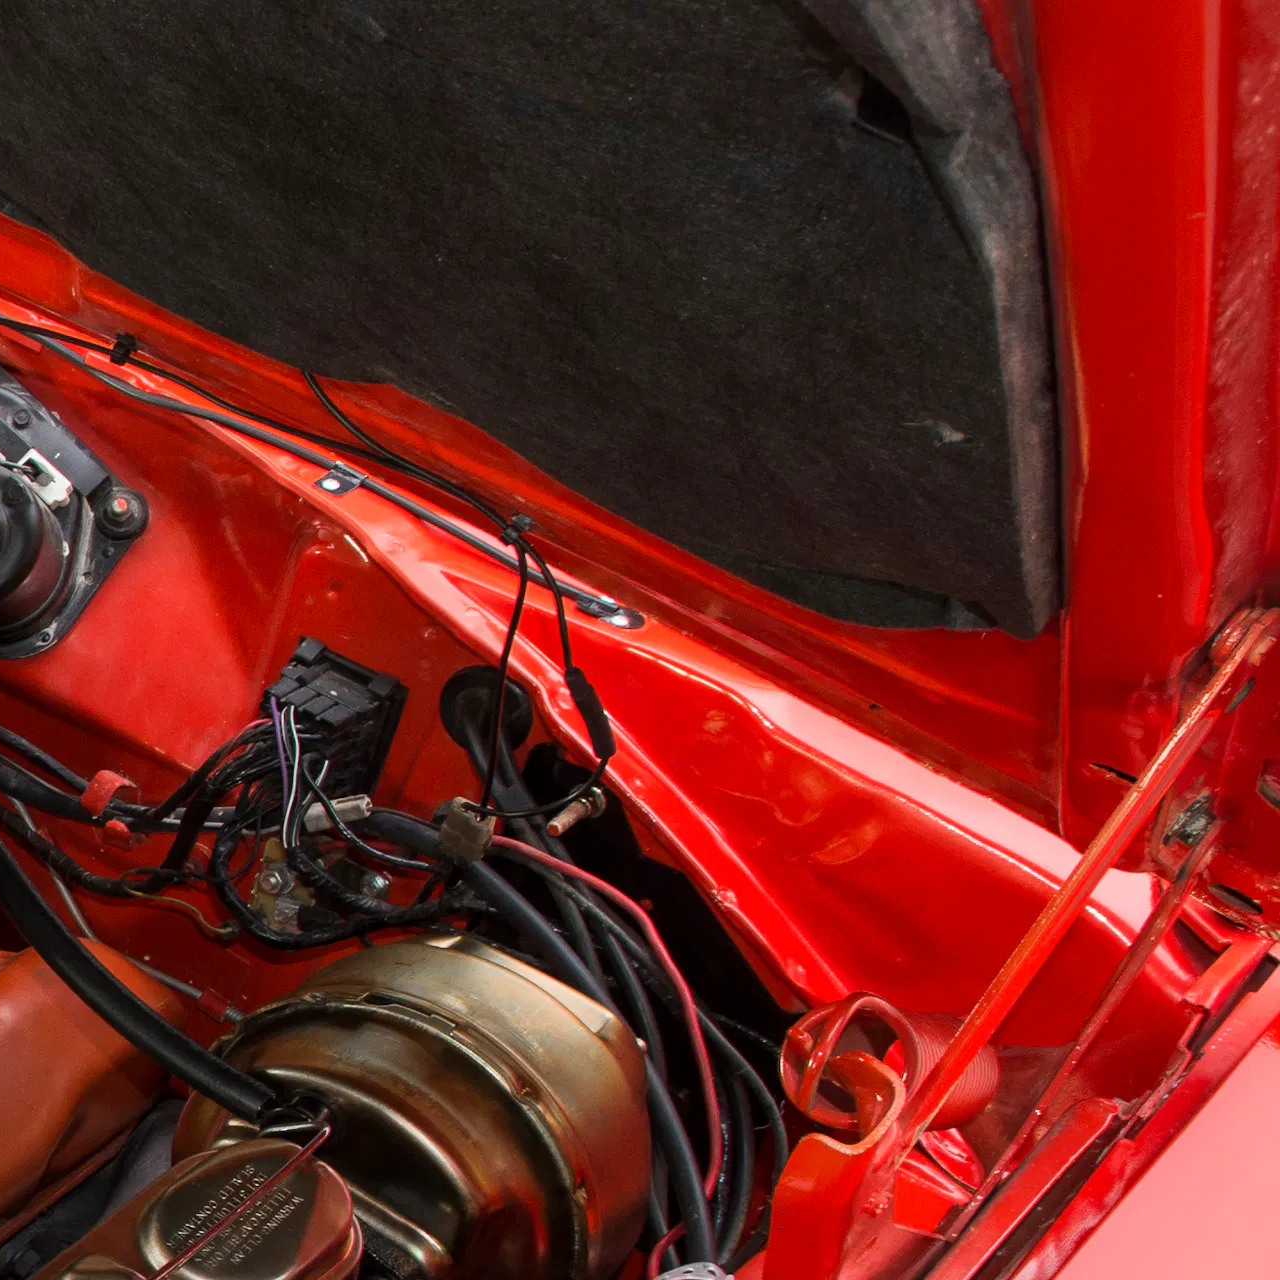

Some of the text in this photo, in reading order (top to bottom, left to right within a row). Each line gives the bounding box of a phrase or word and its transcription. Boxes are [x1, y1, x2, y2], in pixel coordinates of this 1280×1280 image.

[164, 1198, 219, 1251] CONTAINER
[239, 1216, 260, 1238] CAP
[228, 1232, 264, 1266] CLEAN
